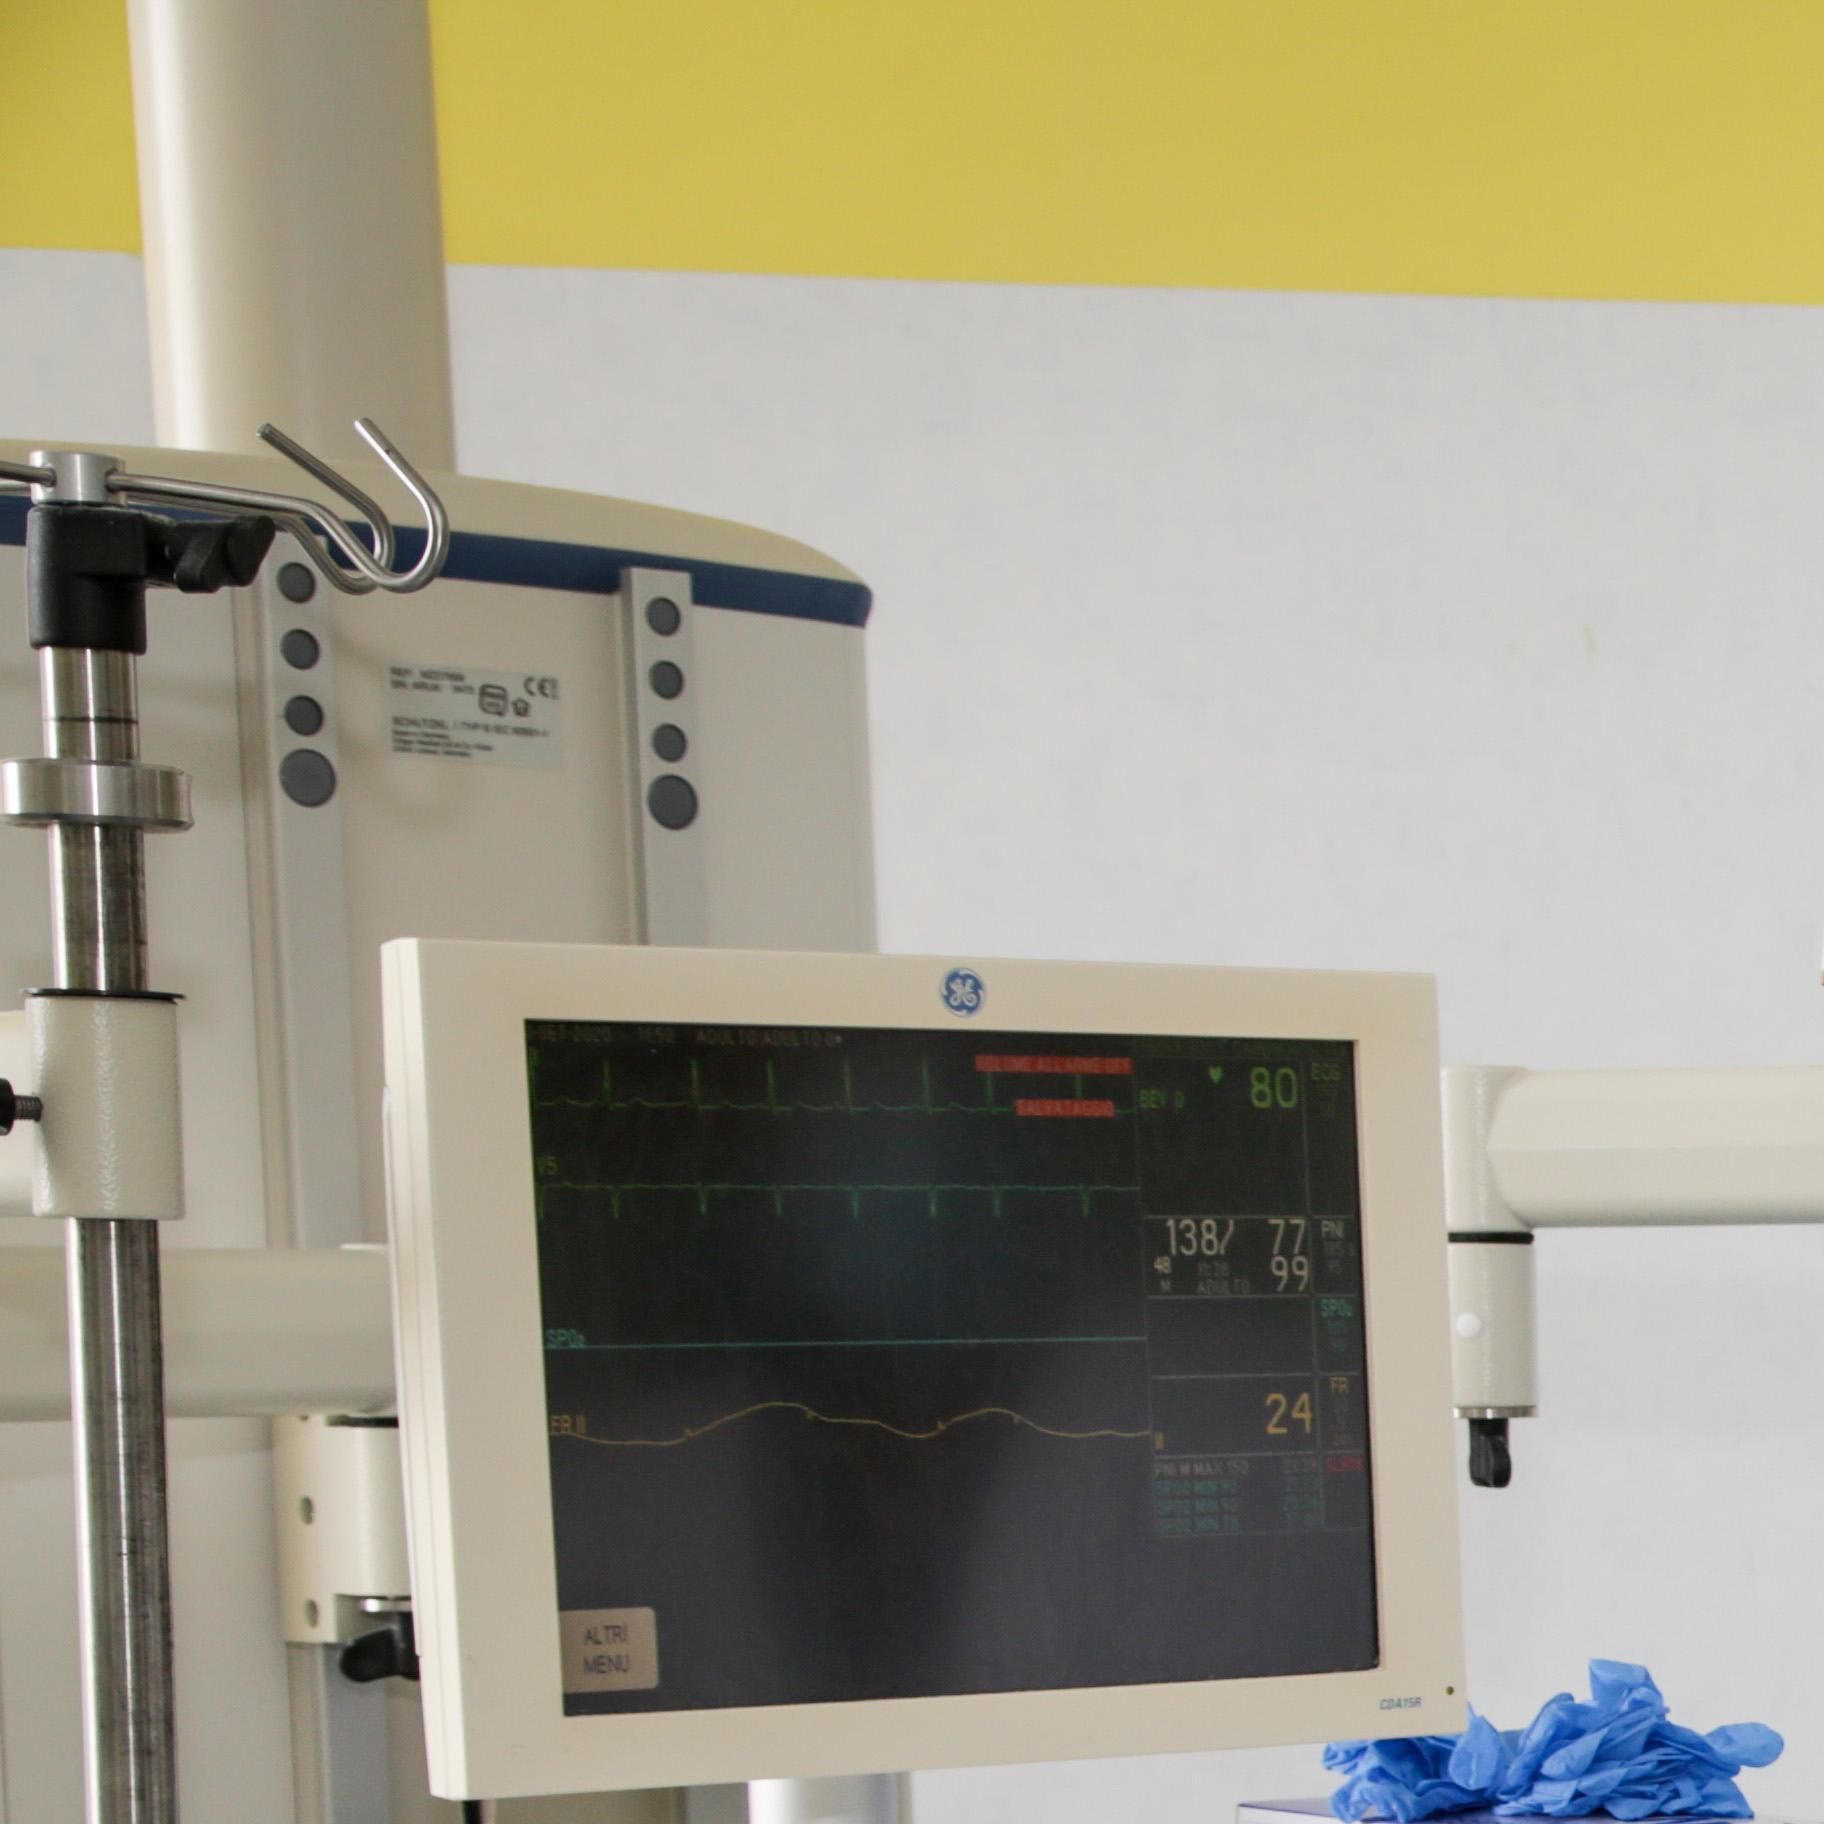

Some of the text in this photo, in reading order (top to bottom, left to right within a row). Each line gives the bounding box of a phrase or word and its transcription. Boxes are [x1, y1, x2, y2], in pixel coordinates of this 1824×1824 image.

[1250, 1066, 1298, 1109] 80
[1268, 1218, 1305, 1255] 77
[1270, 1255, 1309, 1293] 99
[1329, 1376, 1349, 1393] FR
[1265, 1391, 1313, 1435] 24
[584, 1625, 628, 1646] ALTRI
[584, 1655, 629, 1675] MENU
